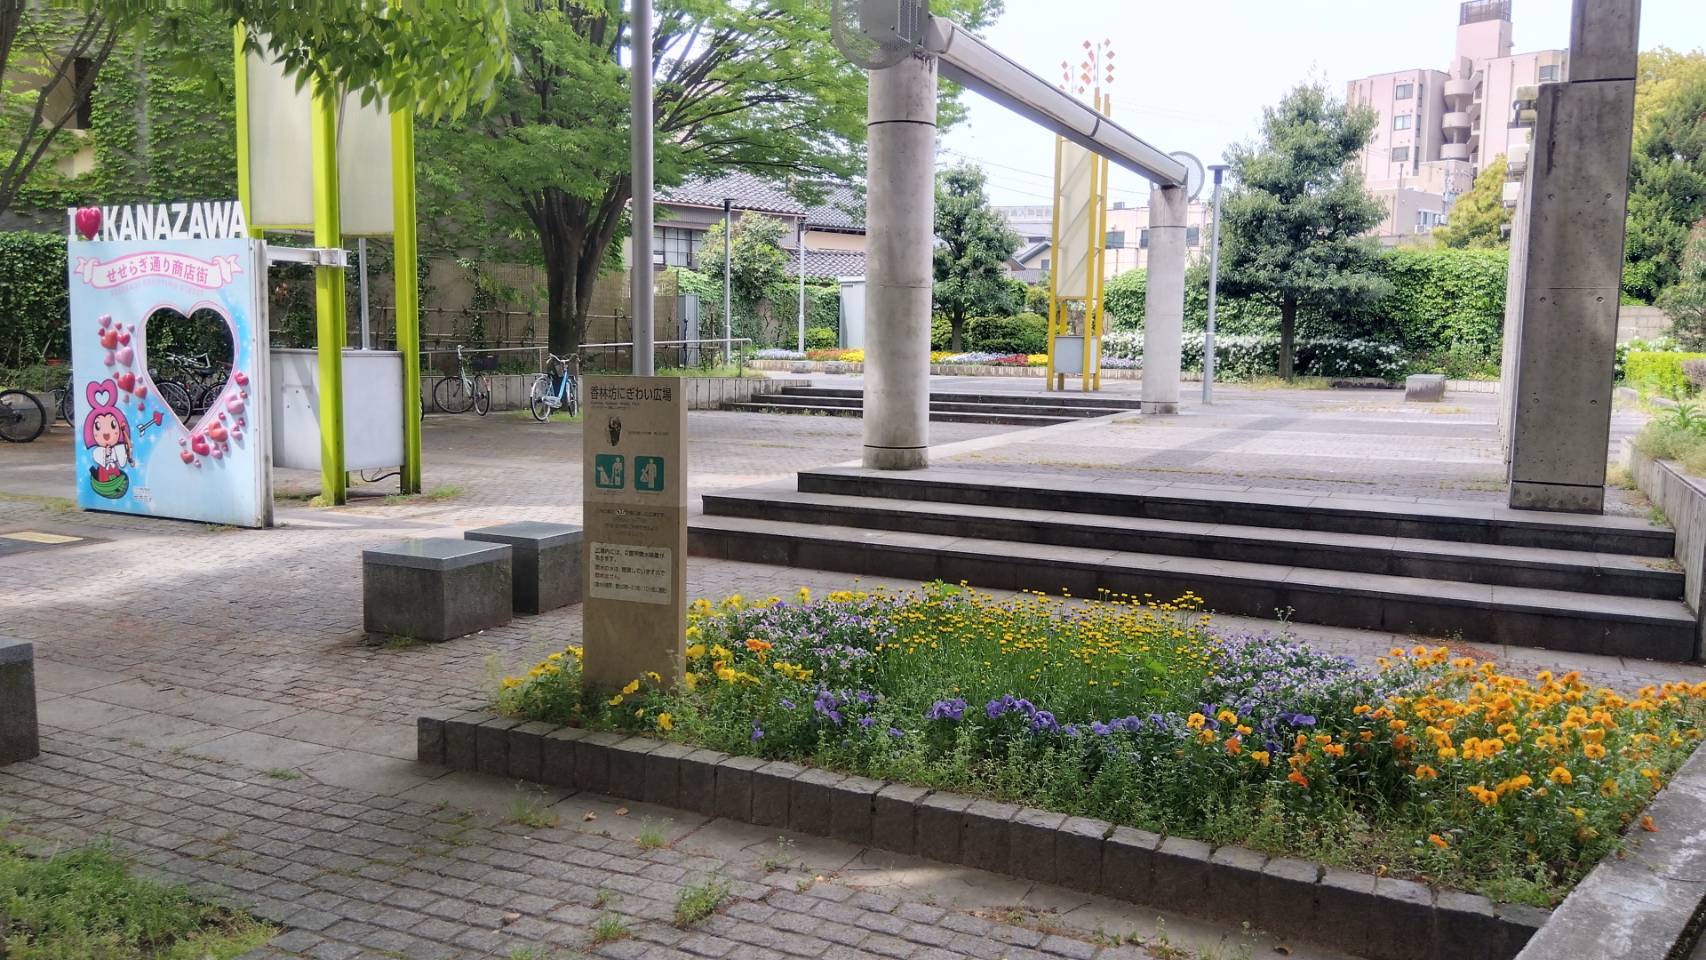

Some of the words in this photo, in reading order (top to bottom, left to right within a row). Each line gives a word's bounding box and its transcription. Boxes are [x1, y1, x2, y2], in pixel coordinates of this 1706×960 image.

[67, 207, 78, 241] I
[103, 200, 249, 241] KANAZAWA
[106, 255, 209, 284] せせらぎ通り商店街
[590, 385, 672, 402] 香林坊にぎわい広場
